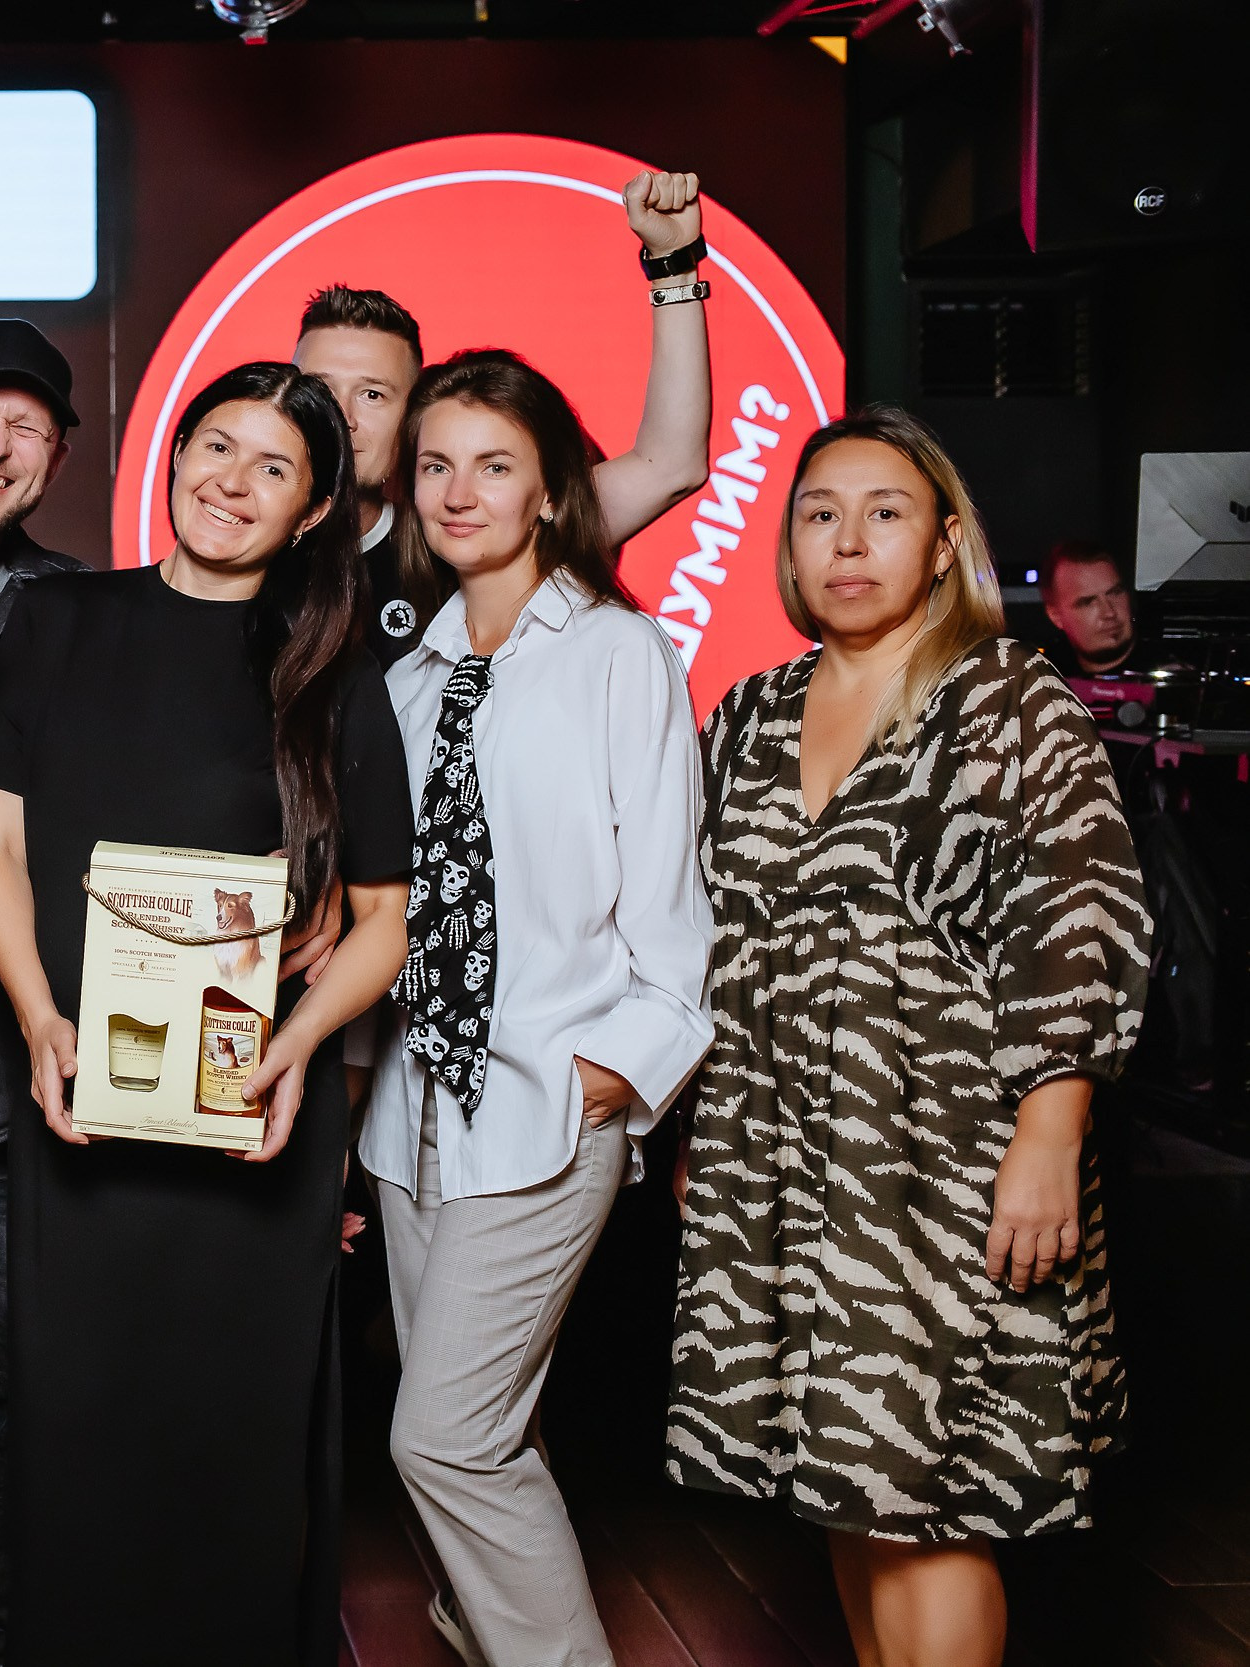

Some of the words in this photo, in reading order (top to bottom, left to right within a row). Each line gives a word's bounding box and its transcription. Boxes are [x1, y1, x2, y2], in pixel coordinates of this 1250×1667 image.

[1138, 194, 1165, 208] RCF
[107, 892, 156, 910] SCOTTISH
[157, 896, 193, 918] COLLIE
[232, 1020, 257, 1033] COLLIE
